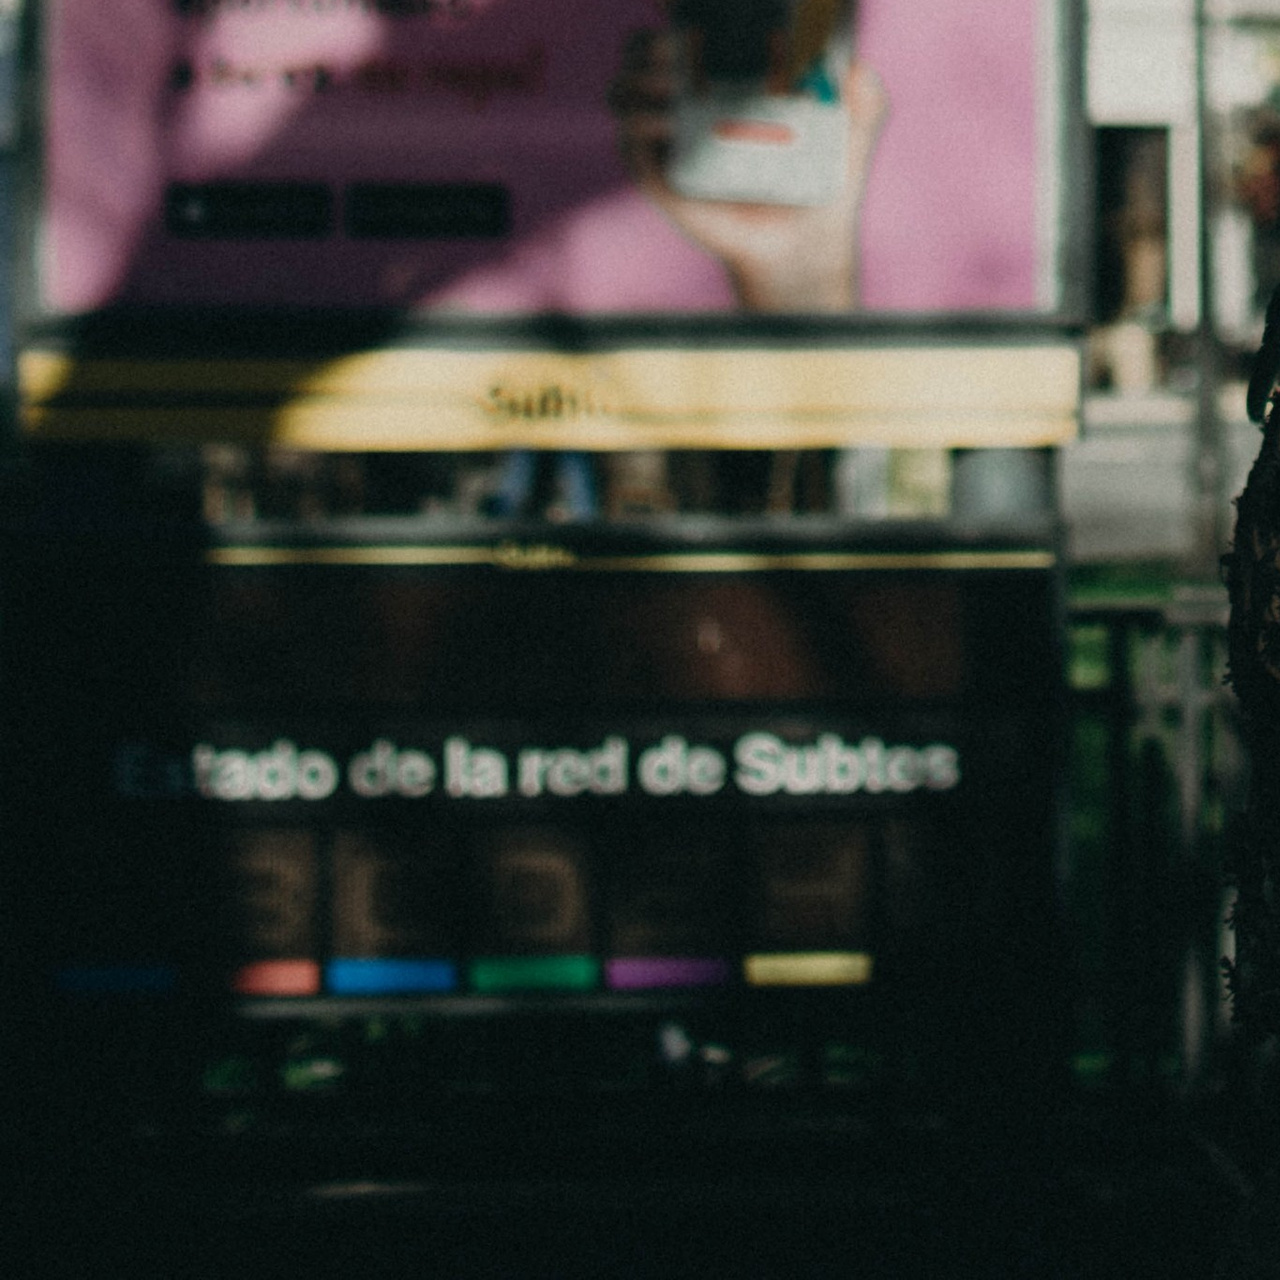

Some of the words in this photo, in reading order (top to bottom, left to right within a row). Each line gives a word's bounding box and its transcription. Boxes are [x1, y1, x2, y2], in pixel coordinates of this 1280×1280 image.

[350, 736, 433, 798] de
[443, 735, 508, 798] la
[518, 731, 629, 797] red
[638, 733, 727, 797] de
